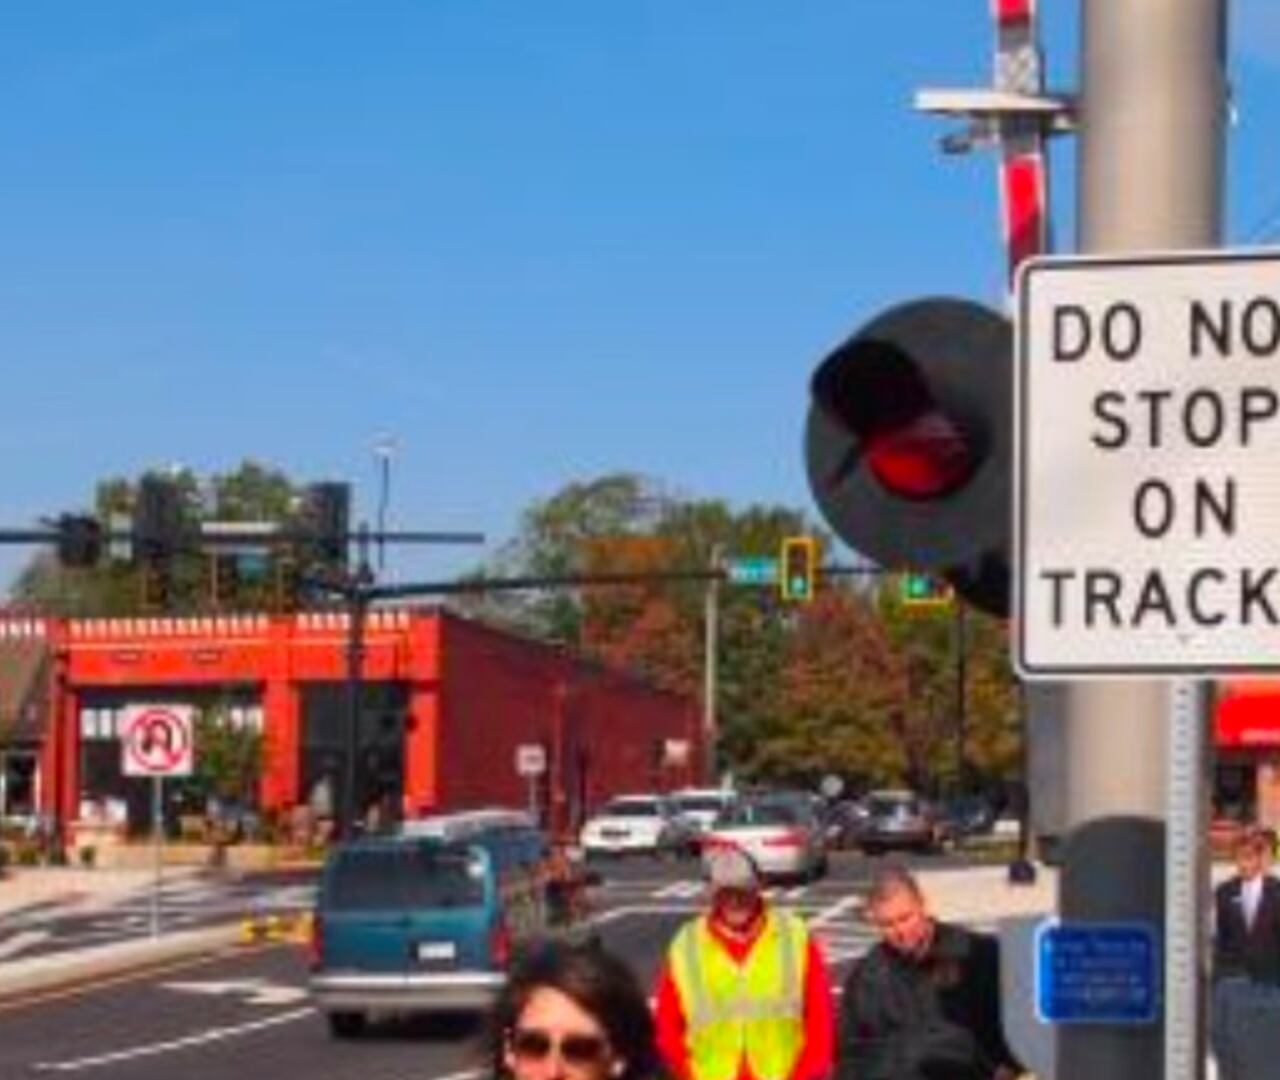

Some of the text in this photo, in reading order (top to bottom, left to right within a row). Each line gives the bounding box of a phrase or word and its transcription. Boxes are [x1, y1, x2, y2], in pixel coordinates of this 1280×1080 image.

[1053, 301, 1142, 362] DO
[1092, 387, 1280, 450] STOP
[1133, 479, 1236, 539] ON
